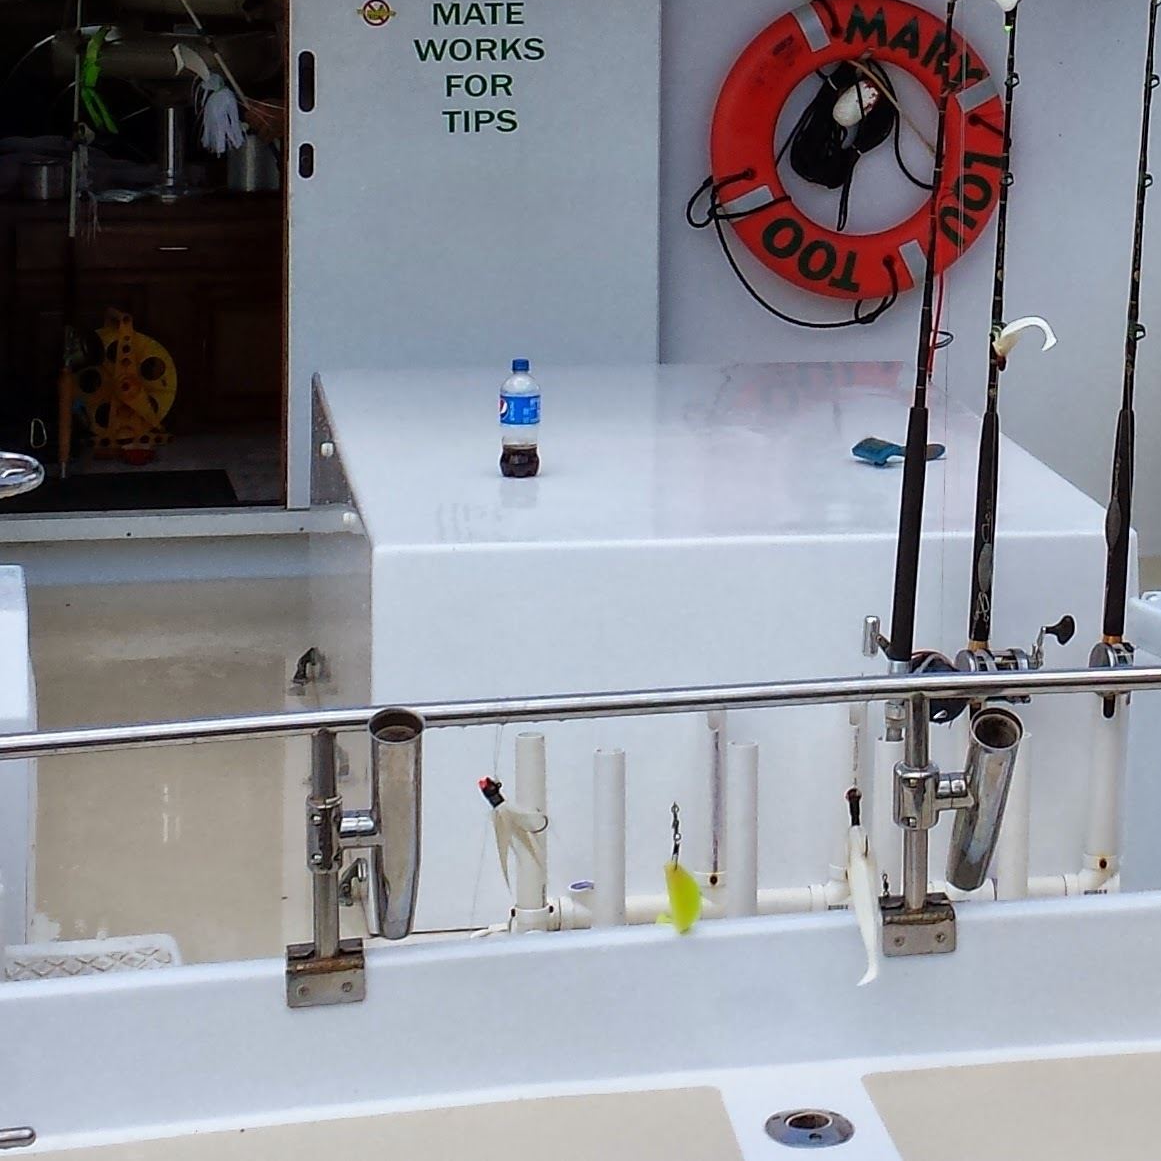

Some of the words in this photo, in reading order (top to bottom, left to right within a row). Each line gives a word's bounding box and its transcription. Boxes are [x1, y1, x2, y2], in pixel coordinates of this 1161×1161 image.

[432, 2, 525, 26] MATE
[413, 37, 546, 62] WORKS
[843, 3, 989, 90] MARY
[445, 74, 513, 98] FOR
[441, 109, 518, 134] TIPS
[938, 150, 1007, 248] LOU
[761, 217, 862, 293] TOO
